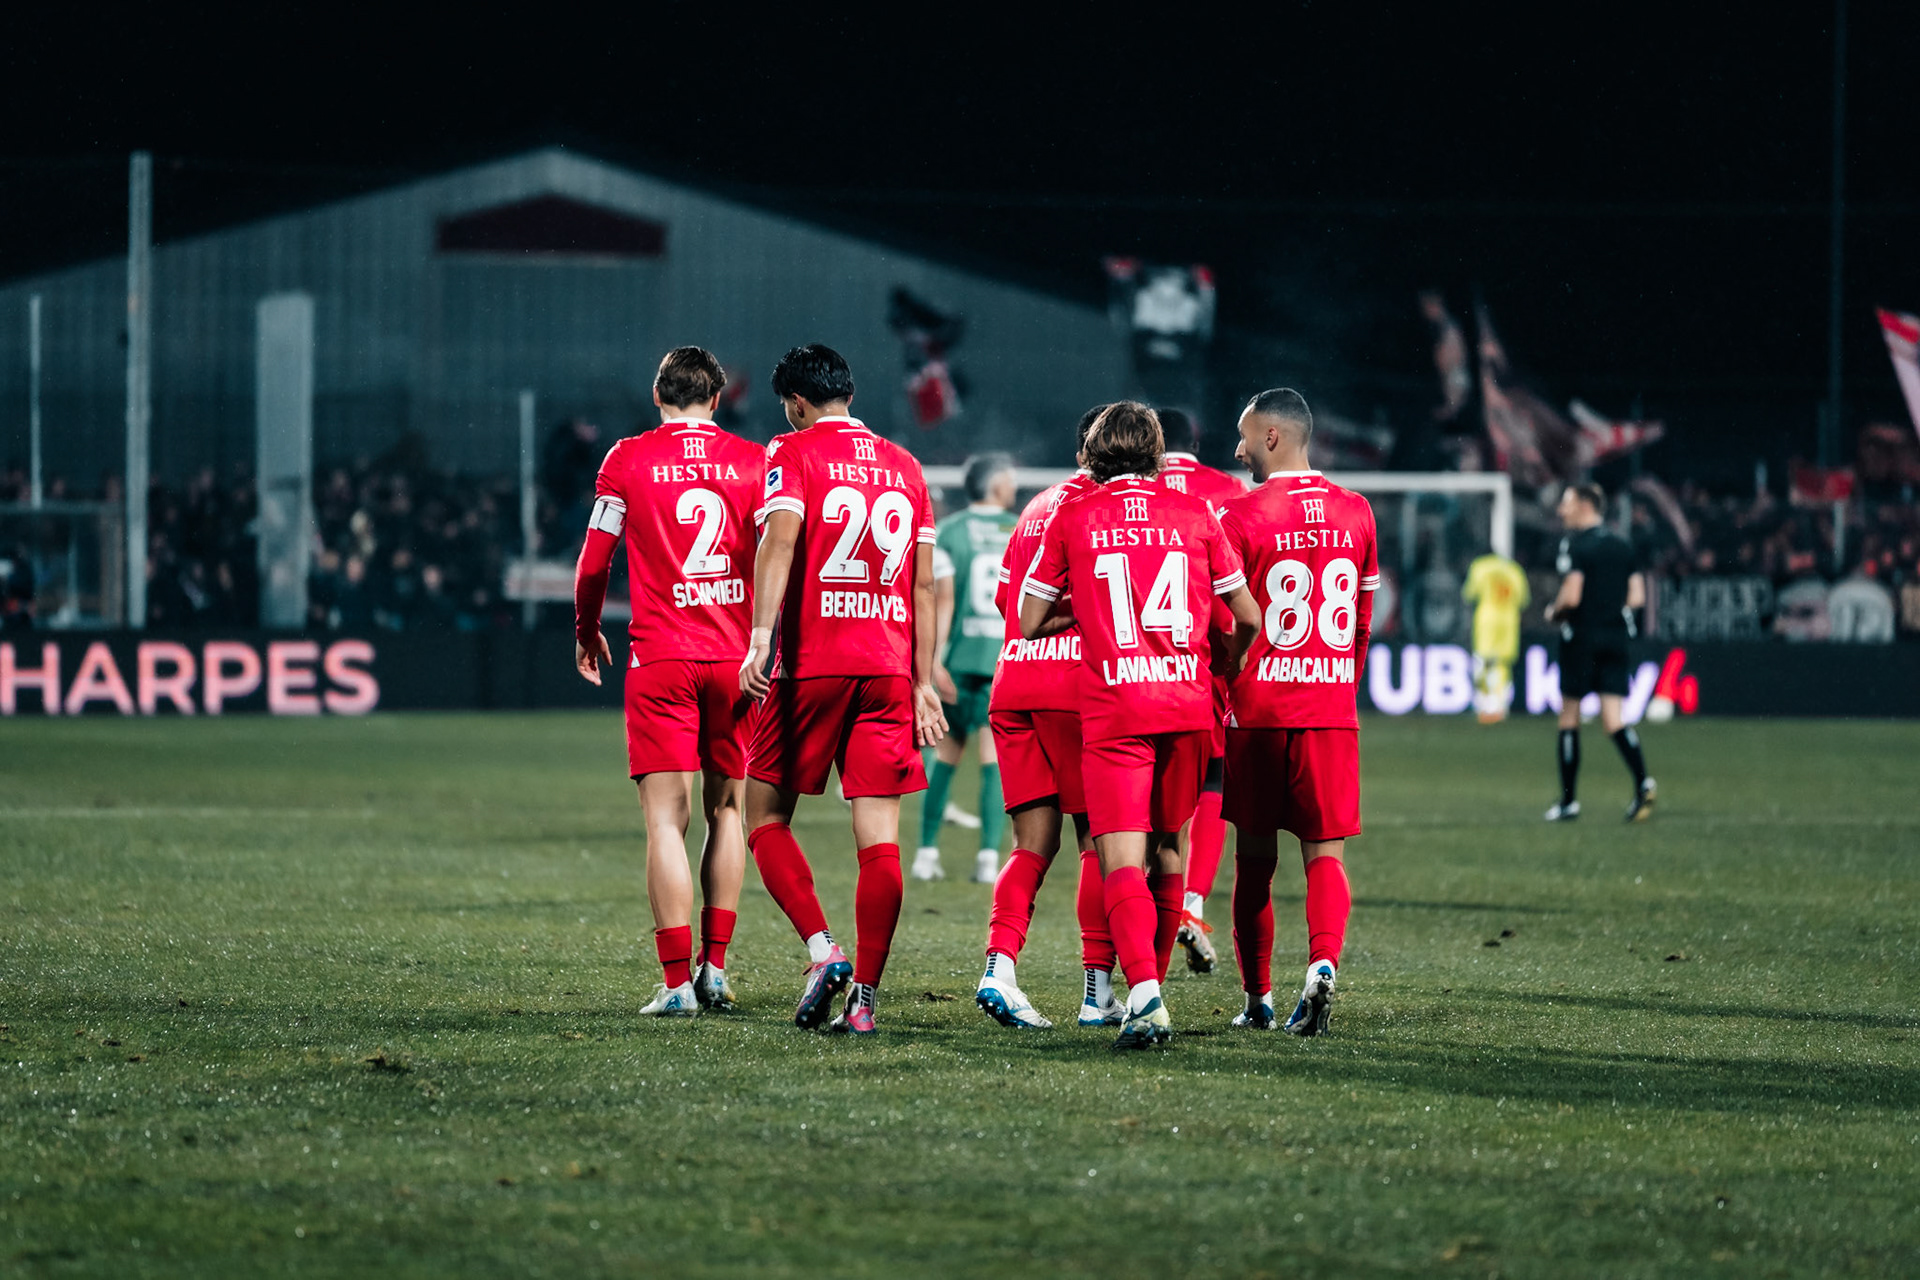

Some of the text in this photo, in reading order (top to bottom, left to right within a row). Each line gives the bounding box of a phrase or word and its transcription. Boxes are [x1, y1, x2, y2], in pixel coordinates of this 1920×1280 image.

[652, 463, 740, 483] HESTIA
[828, 463, 907, 489] HESTIA
[675, 488, 731, 580] 2
[819, 486, 914, 587] 29
[1091, 528, 1184, 549] HESTIA
[1274, 529, 1354, 552] HESTIA
[1094, 551, 1193, 650] 14
[1265, 557, 1358, 652] 88
[0, 641, 380, 716] HARPES
[1102, 654, 1198, 686] LAVANCHY
[1368, 643, 1514, 716] UB
